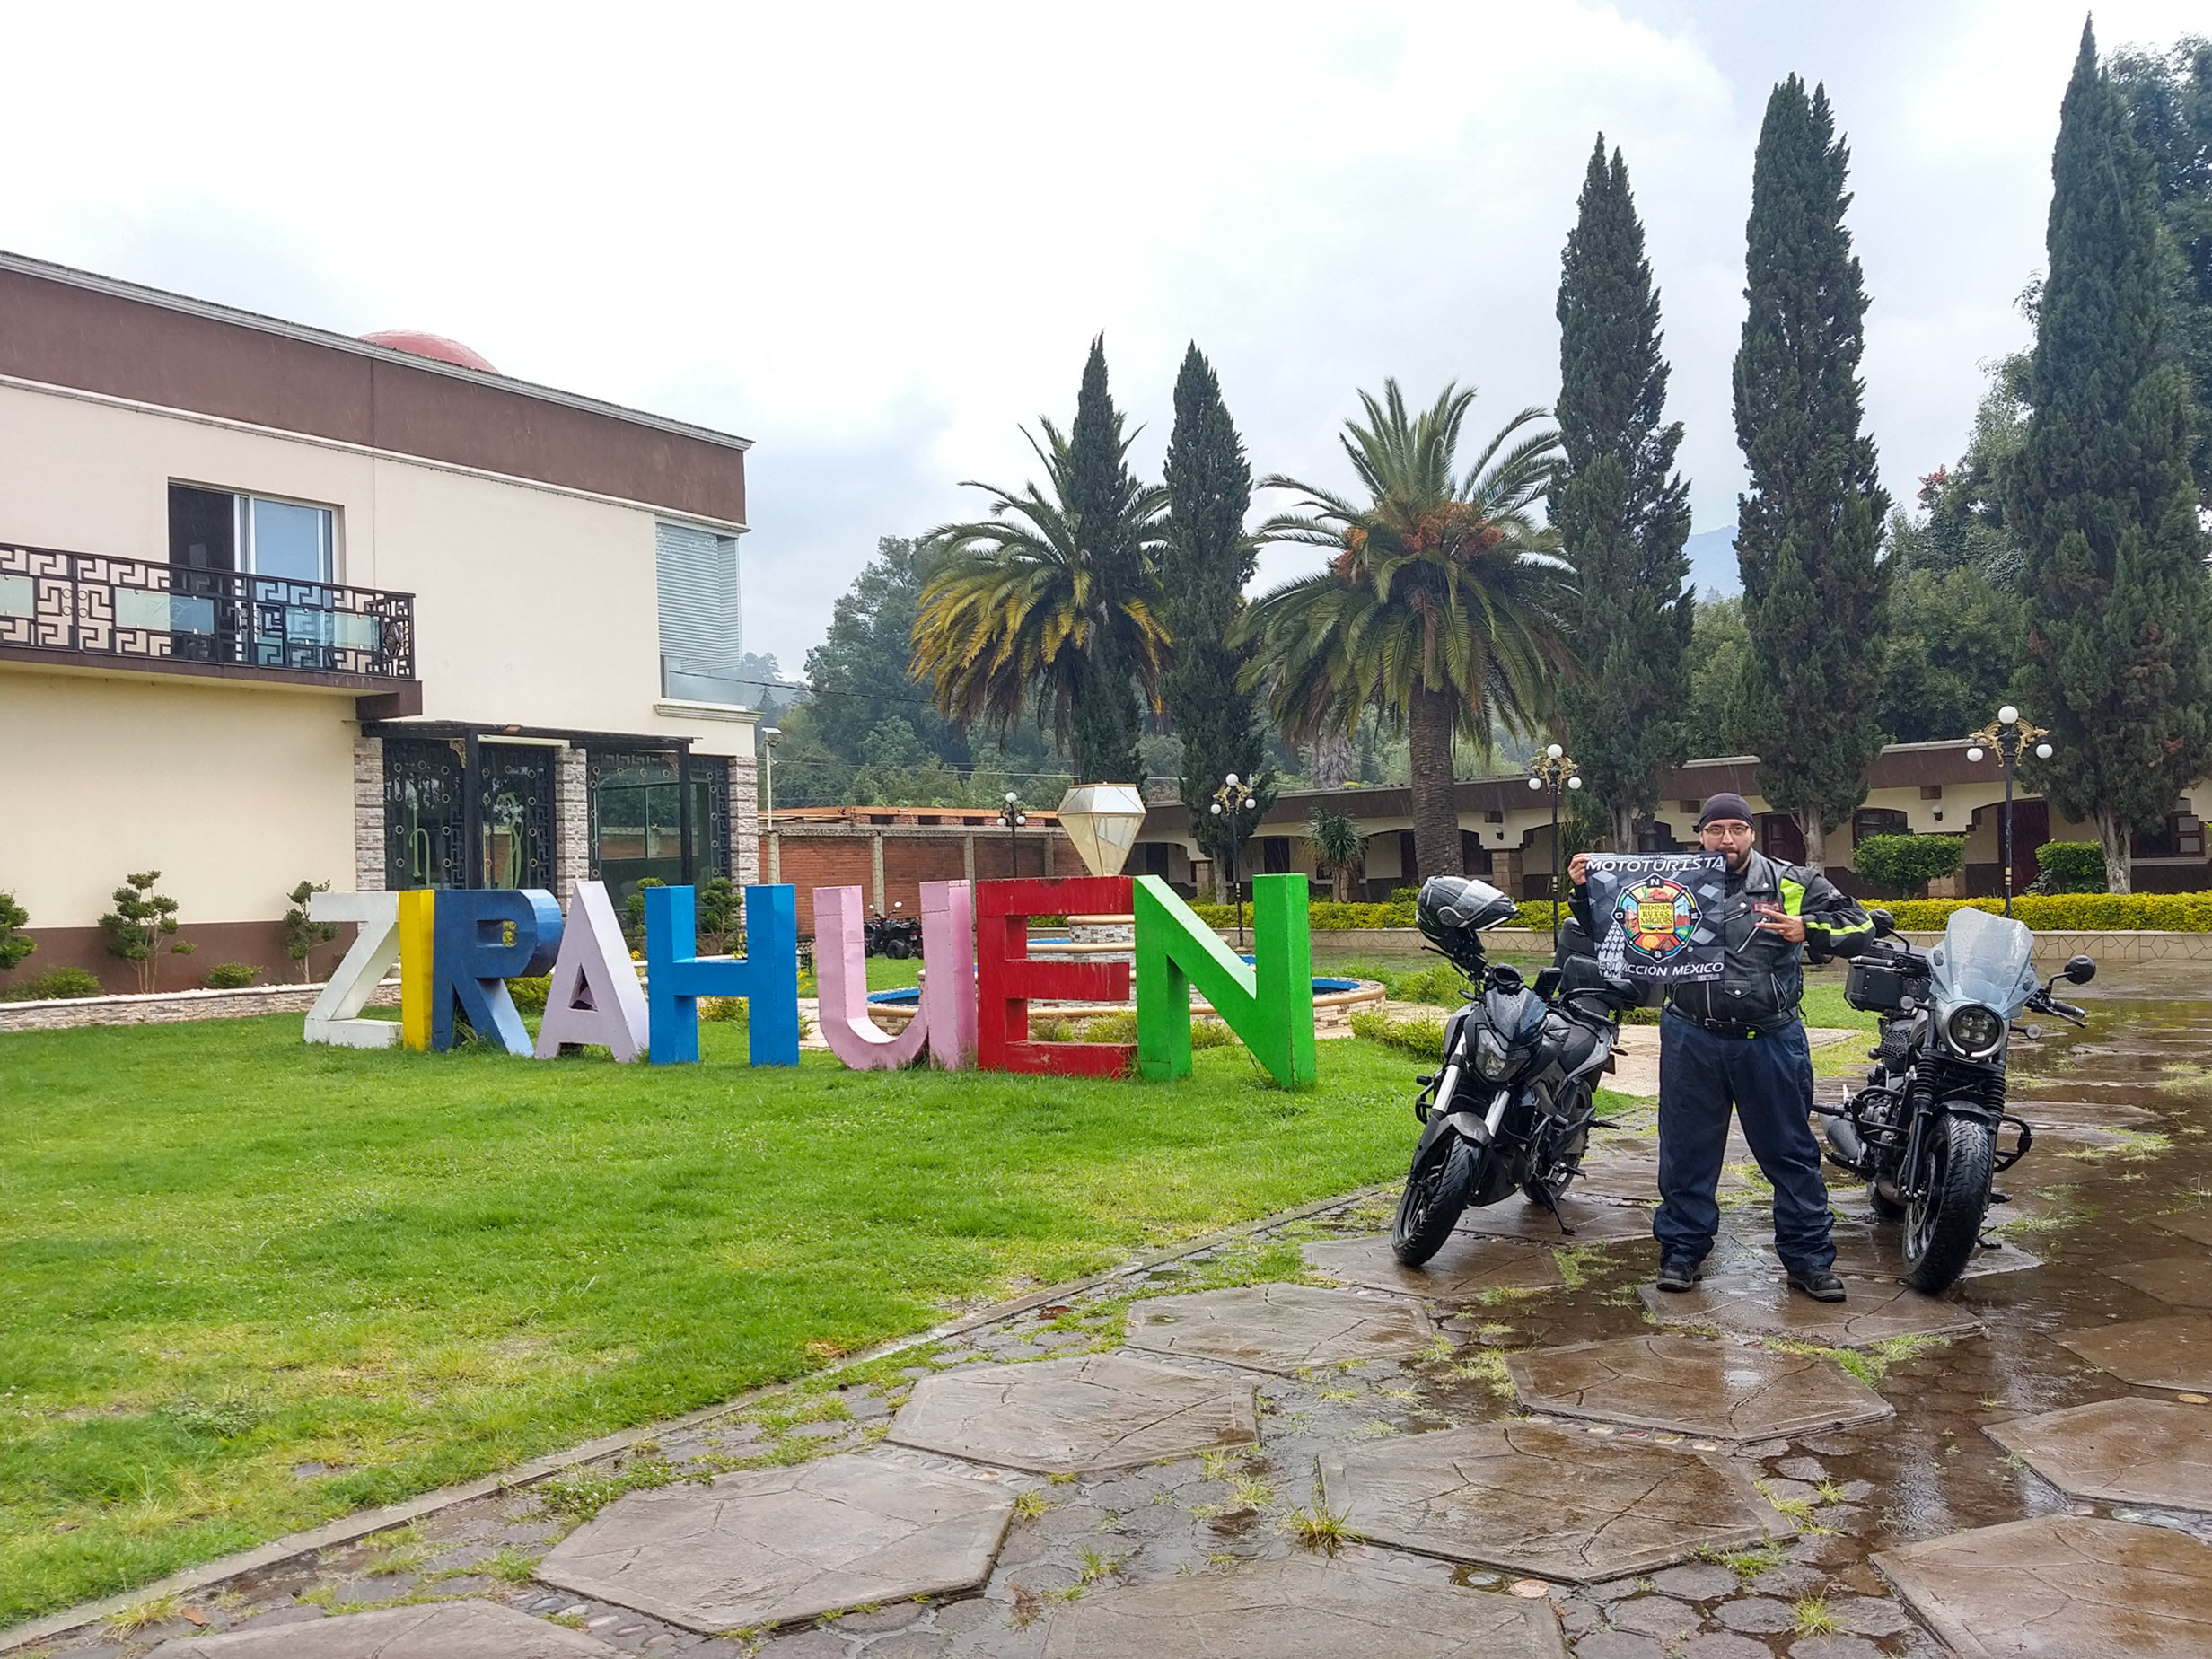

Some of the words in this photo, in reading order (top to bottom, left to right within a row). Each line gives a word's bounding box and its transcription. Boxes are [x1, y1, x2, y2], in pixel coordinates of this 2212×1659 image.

[1585, 856, 1725, 873] MOTOTURISTA
[1650, 878, 1660, 886] N
[1654, 951, 1663, 959] S
[1621, 963, 1668, 977] ACCIÓN
[1672, 961, 1724, 977] MÉXICO
[303, 873, 1316, 1090] ZIRAHUEN
